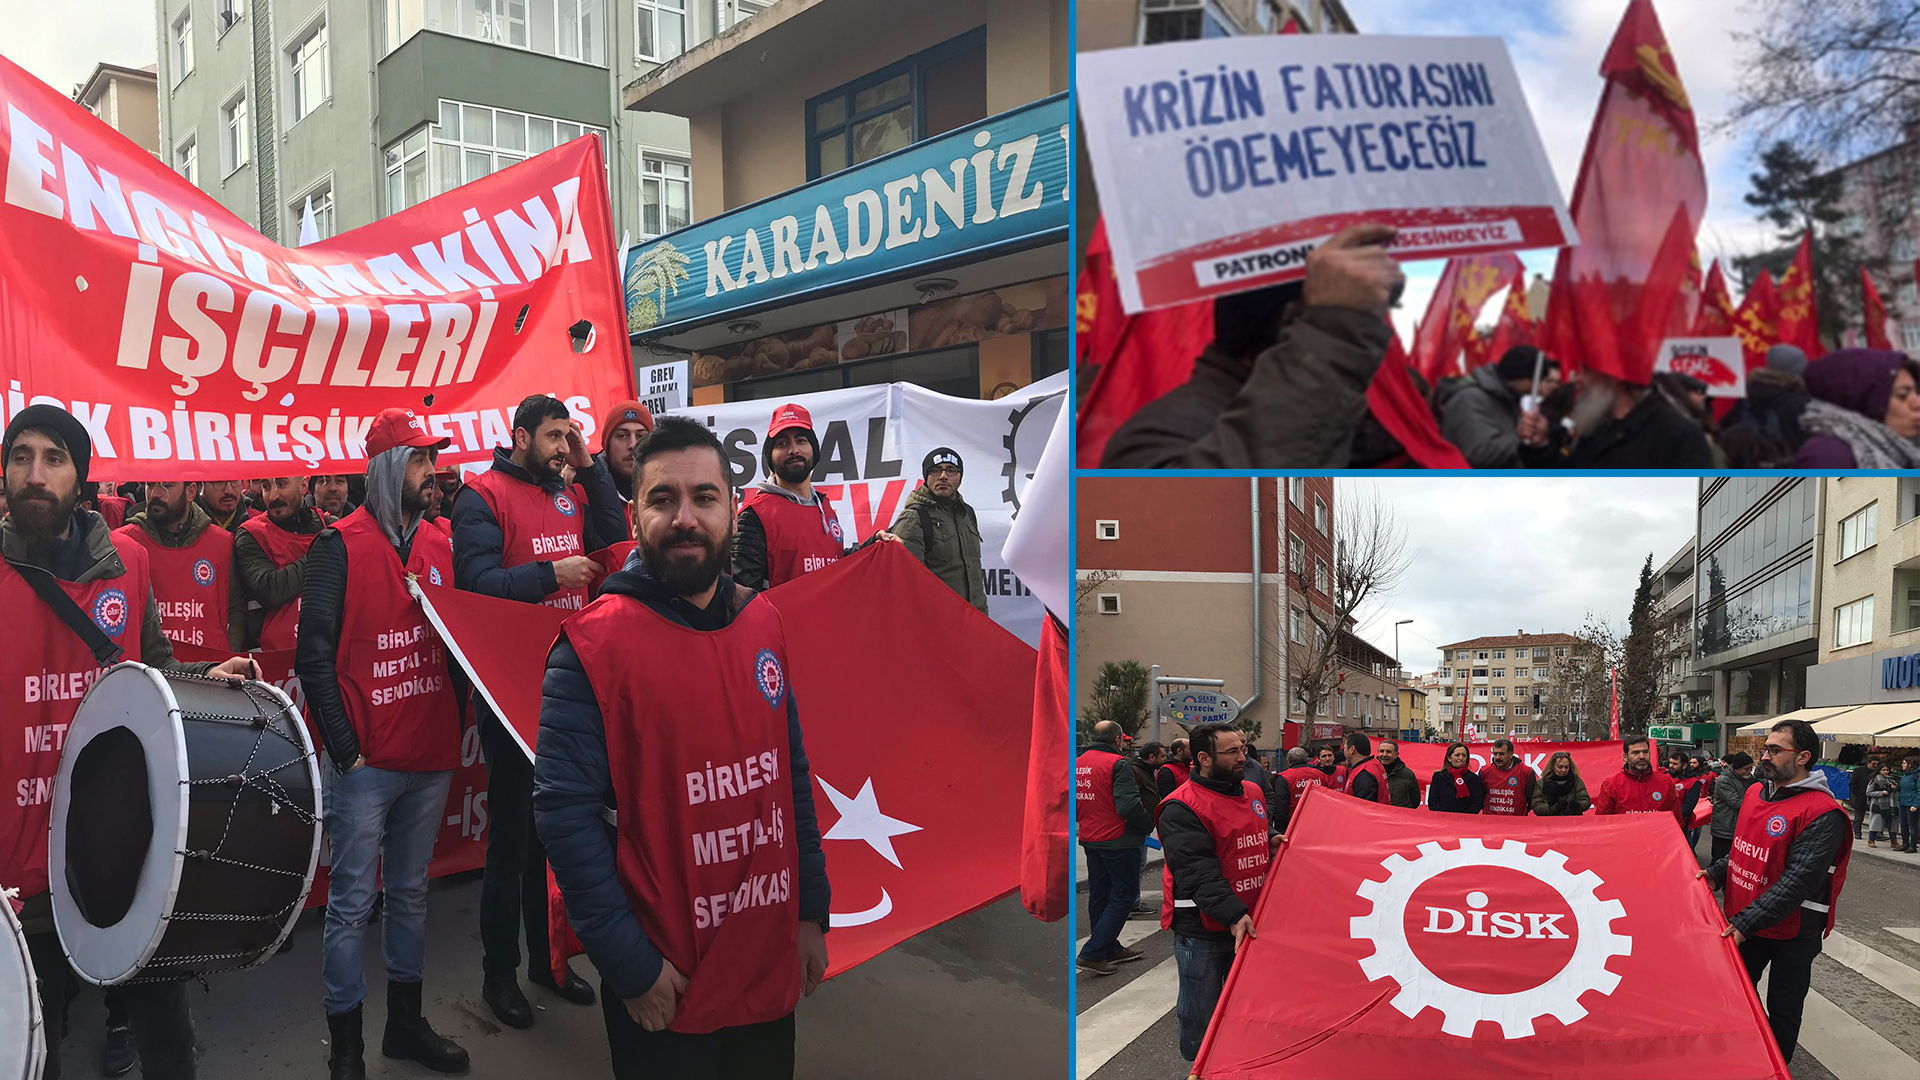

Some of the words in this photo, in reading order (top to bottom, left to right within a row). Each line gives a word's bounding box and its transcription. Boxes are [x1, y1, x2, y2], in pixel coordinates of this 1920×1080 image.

[1124, 64, 1264, 137] KRİZİN
[1279, 62, 1495, 114] FATURASINI
[1184, 114, 1487, 199] ÖDEMEYECEĞİZ
[704, 130, 1044, 298] KARADENİZ
[302, 176, 593, 299] MAKİNA
[1385, 226, 1509, 249] NSESİNDEYİZ
[116, 244, 500, 403] İŞÇİLERİ
[651, 366, 675, 383] GREV
[532, 531, 580, 555] BİRLEŞİK
[1171, 710, 1201, 722] ÇOCUK
[1202, 713, 1227, 722] PARKI
[1184, 705, 1215, 713] AYŞECİK
[25, 723, 67, 753] MET
[16, 775, 57, 807] SEN
[1423, 891, 1570, 939] DİSK
